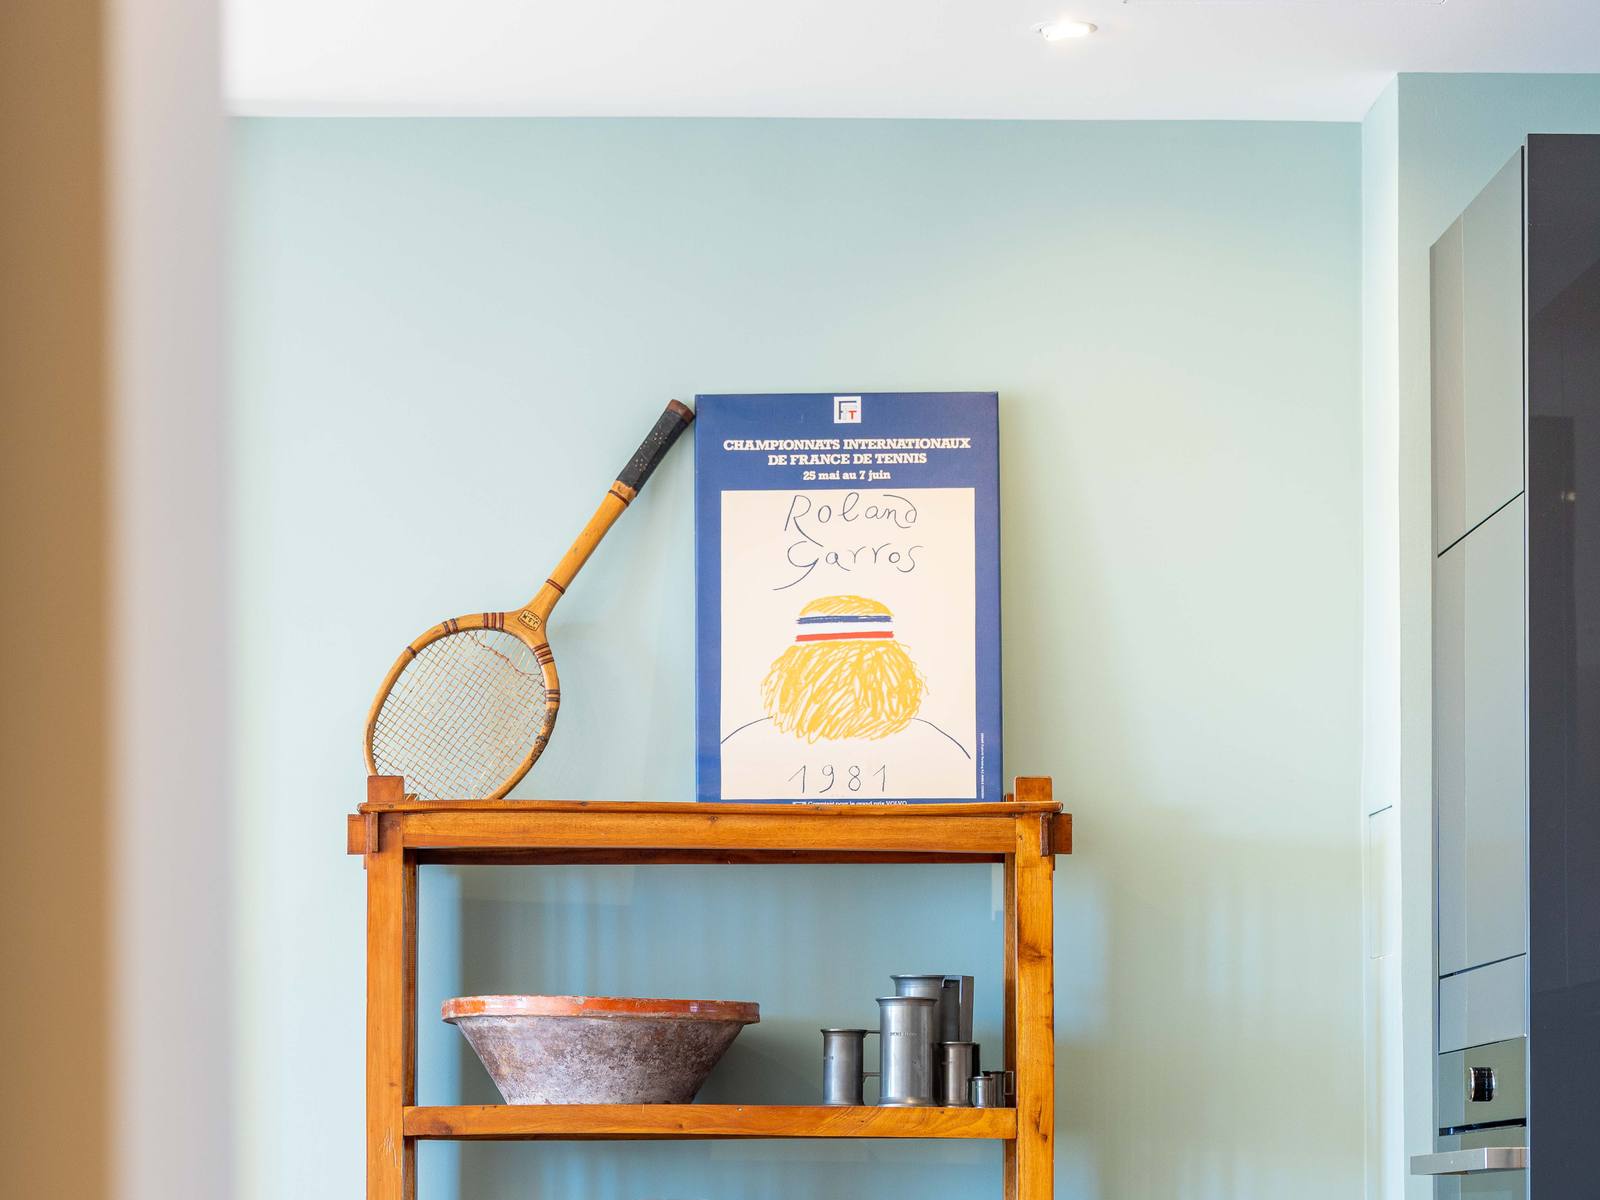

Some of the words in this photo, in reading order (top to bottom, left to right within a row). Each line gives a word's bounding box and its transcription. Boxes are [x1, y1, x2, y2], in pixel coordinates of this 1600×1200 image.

[723, 439, 840, 450] CHAMPIONNATS
[843, 438, 971, 450] INTERNATIONAUX
[768, 455, 787, 465] DE
[790, 454, 850, 465] FRANCE
[853, 454, 872, 464] DE
[875, 453, 928, 464] TENNIS
[802, 471, 816, 480] 25
[818, 470, 840, 480] mai
[842, 472, 857, 480] au
[860, 470, 866, 480] 7
[868, 470, 891, 481] juin
[784, 492, 918, 548] Roland
[772, 540, 924, 591] Garros
[788, 764, 886, 794] 1981
